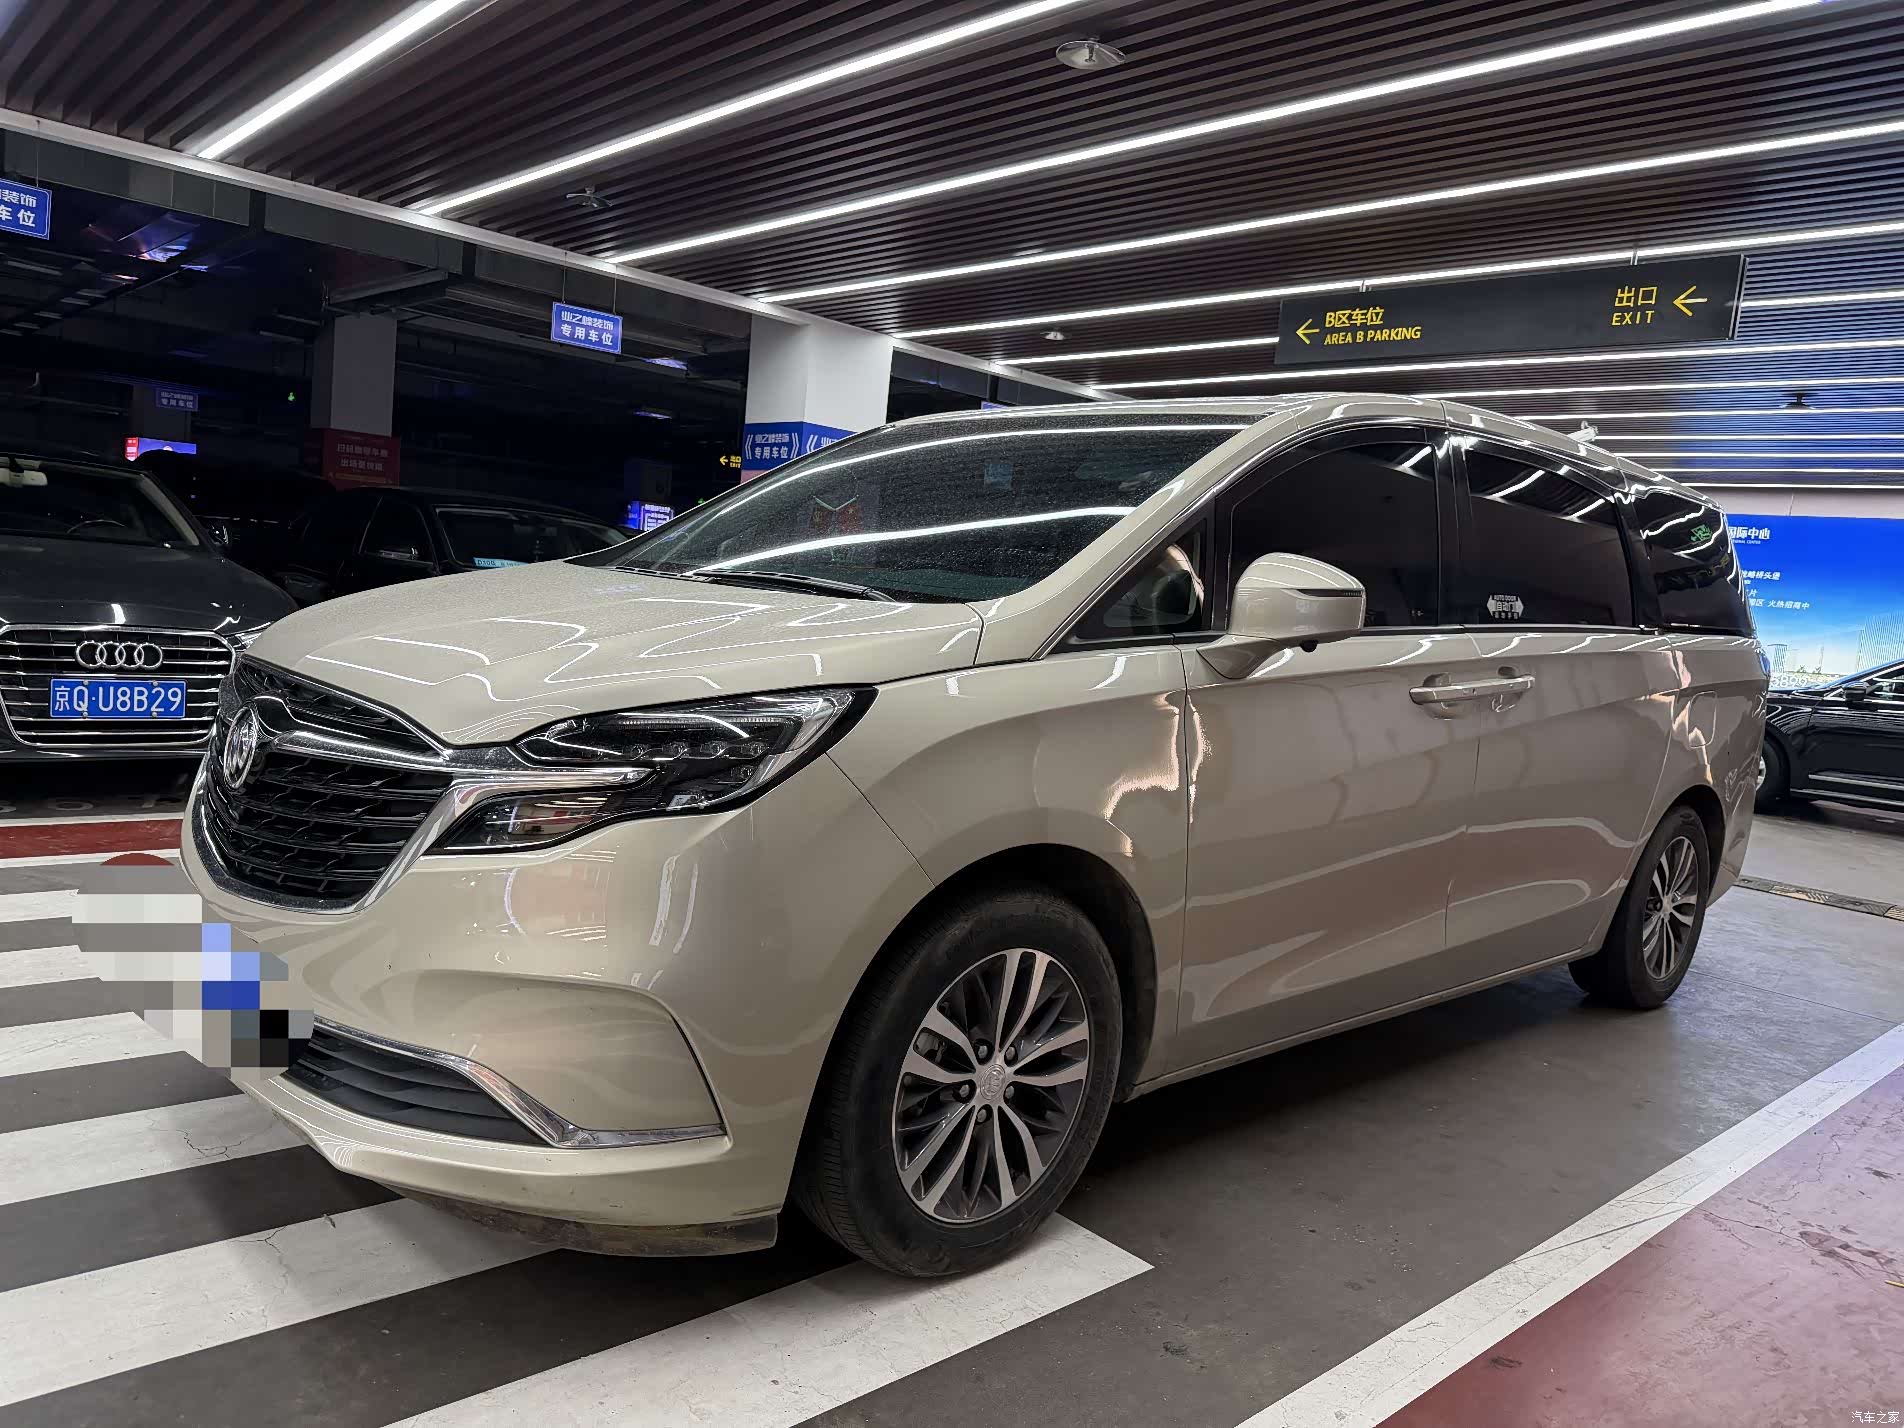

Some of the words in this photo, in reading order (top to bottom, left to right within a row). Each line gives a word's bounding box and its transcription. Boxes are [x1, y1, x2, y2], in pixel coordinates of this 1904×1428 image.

[0, 189, 37, 208] 装饰
[1614, 286, 1658, 307] 出口
[1325, 306, 1384, 328] B区车位
[1612, 310, 1655, 326] EXIT
[561, 323, 613, 346] 专用车位
[1324, 332, 1352, 345] AREA
[1356, 331, 1364, 343] B
[1367, 326, 1421, 342] PARKING
[729, 455, 742, 463] 出口
[754, 446, 789, 459] 专用车位
[54, 685, 182, 712] 京Q·U8B29
